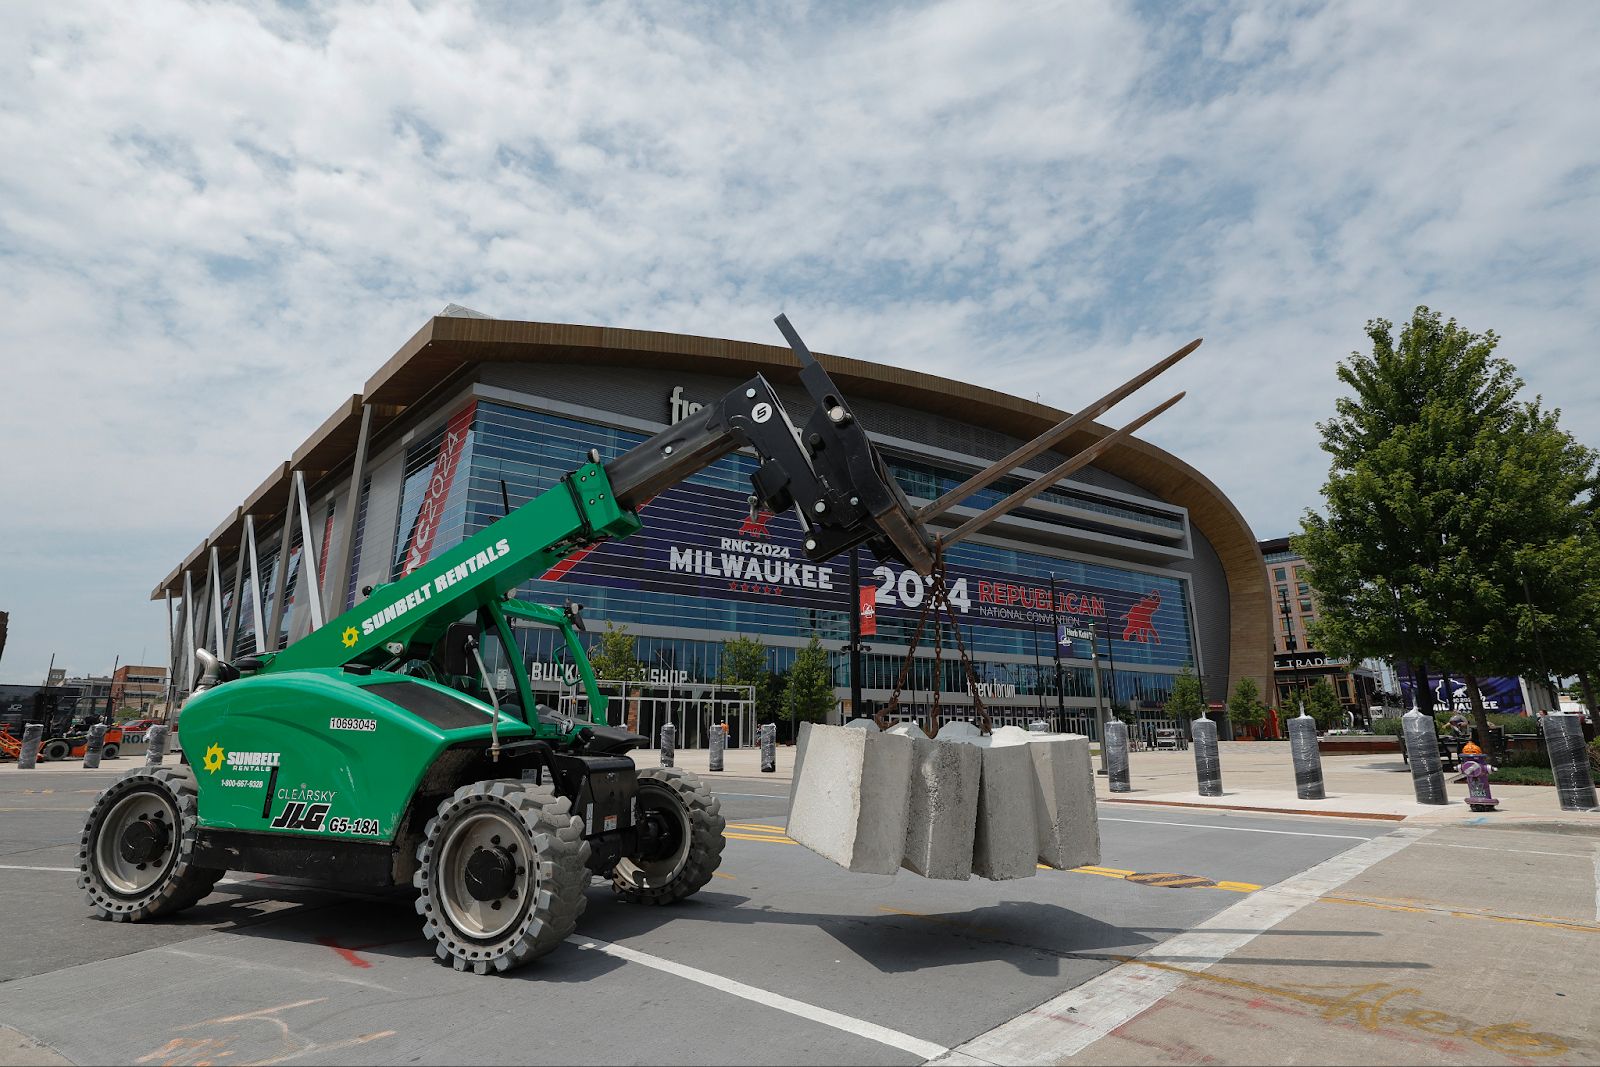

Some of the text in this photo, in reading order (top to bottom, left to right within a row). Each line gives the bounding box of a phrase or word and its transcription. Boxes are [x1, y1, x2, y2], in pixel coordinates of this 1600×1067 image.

[406, 431, 459, 575] NC2024
[669, 546, 834, 590] MILWAUKEE
[361, 538, 511, 636] SUNBELT RENTALS
[978, 580, 1107, 617] REPUBLICAN
[979, 605, 1081, 627] NATIONAL CONVENTION
[531, 662, 577, 683] BUCK
[650, 668, 688, 687] SHOP
[1286, 656, 1332, 669] TRADE
[331, 718, 376, 731] 10693045
[227, 752, 280, 767] SUNBELT
[277, 787, 336, 802] CLEARSKY
[270, 801, 380, 836] JLG G5-18A
